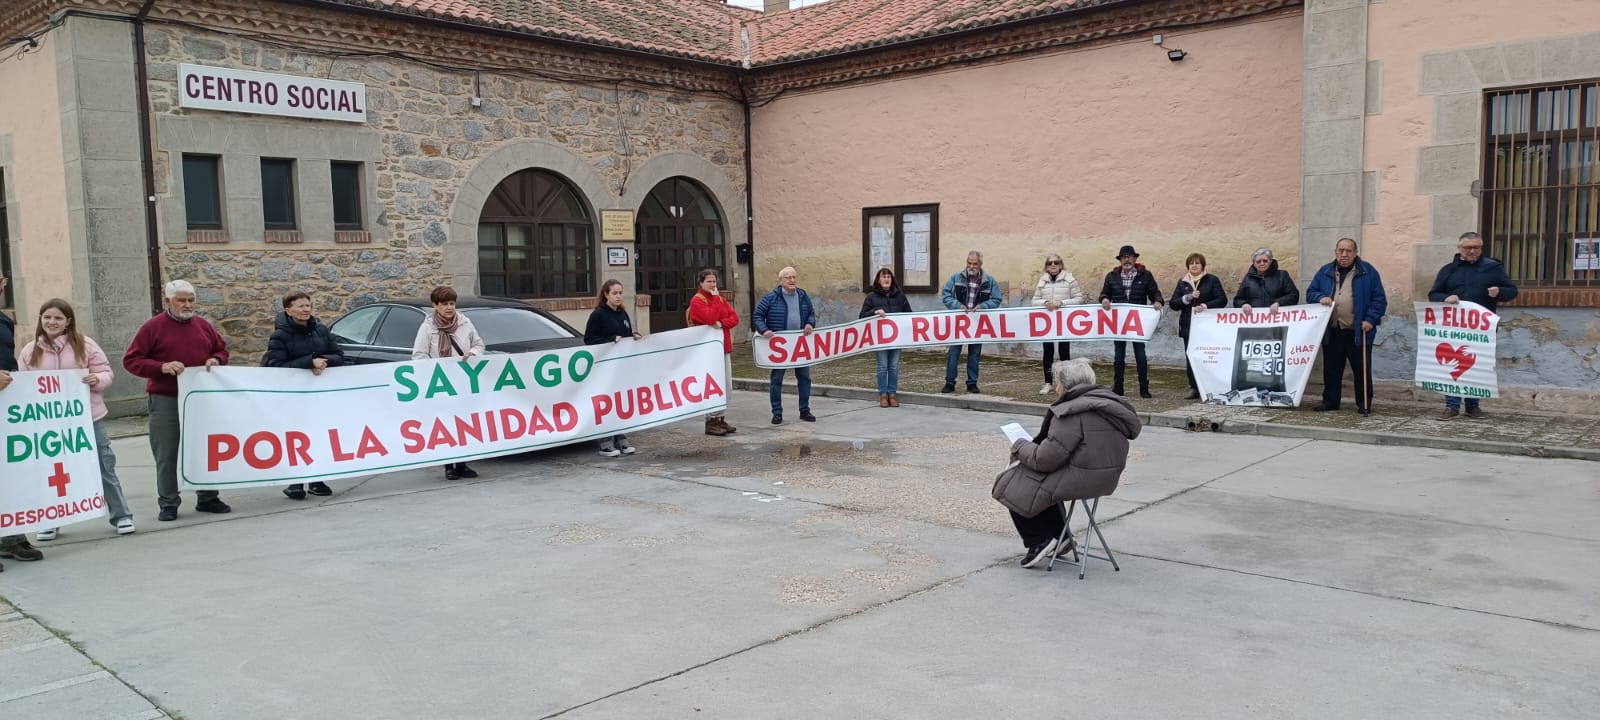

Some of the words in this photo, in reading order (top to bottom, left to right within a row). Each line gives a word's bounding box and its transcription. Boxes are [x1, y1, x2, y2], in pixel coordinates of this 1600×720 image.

[185, 73, 278, 106] CENTRO
[287, 84, 363, 113] SOCIAL
[1424, 307, 1436, 325] A
[1442, 306, 1492, 331] ELLOS
[767, 318, 899, 364] SANIDAD
[912, 313, 1016, 342] RURAL
[1029, 309, 1145, 337] DIGNA
[1424, 328, 1436, 337] NO
[1440, 330, 1448, 338] LE
[1451, 331, 1489, 343] IMPORTA
[1244, 342, 1281, 355] 1699
[394, 350, 594, 402] SAYAGO
[1265, 360, 1283, 373] 30
[37, 375, 61, 394] SIN
[1422, 381, 1460, 395] NUESTRA
[1463, 386, 1491, 398] SALUD
[7, 399, 84, 424] SANIDAD
[207, 430, 314, 472] POR
[328, 425, 389, 462] LA
[400, 402, 579, 454] SANIDAD
[591, 372, 724, 426] PUBLICA
[6, 426, 93, 463] DIGNA
